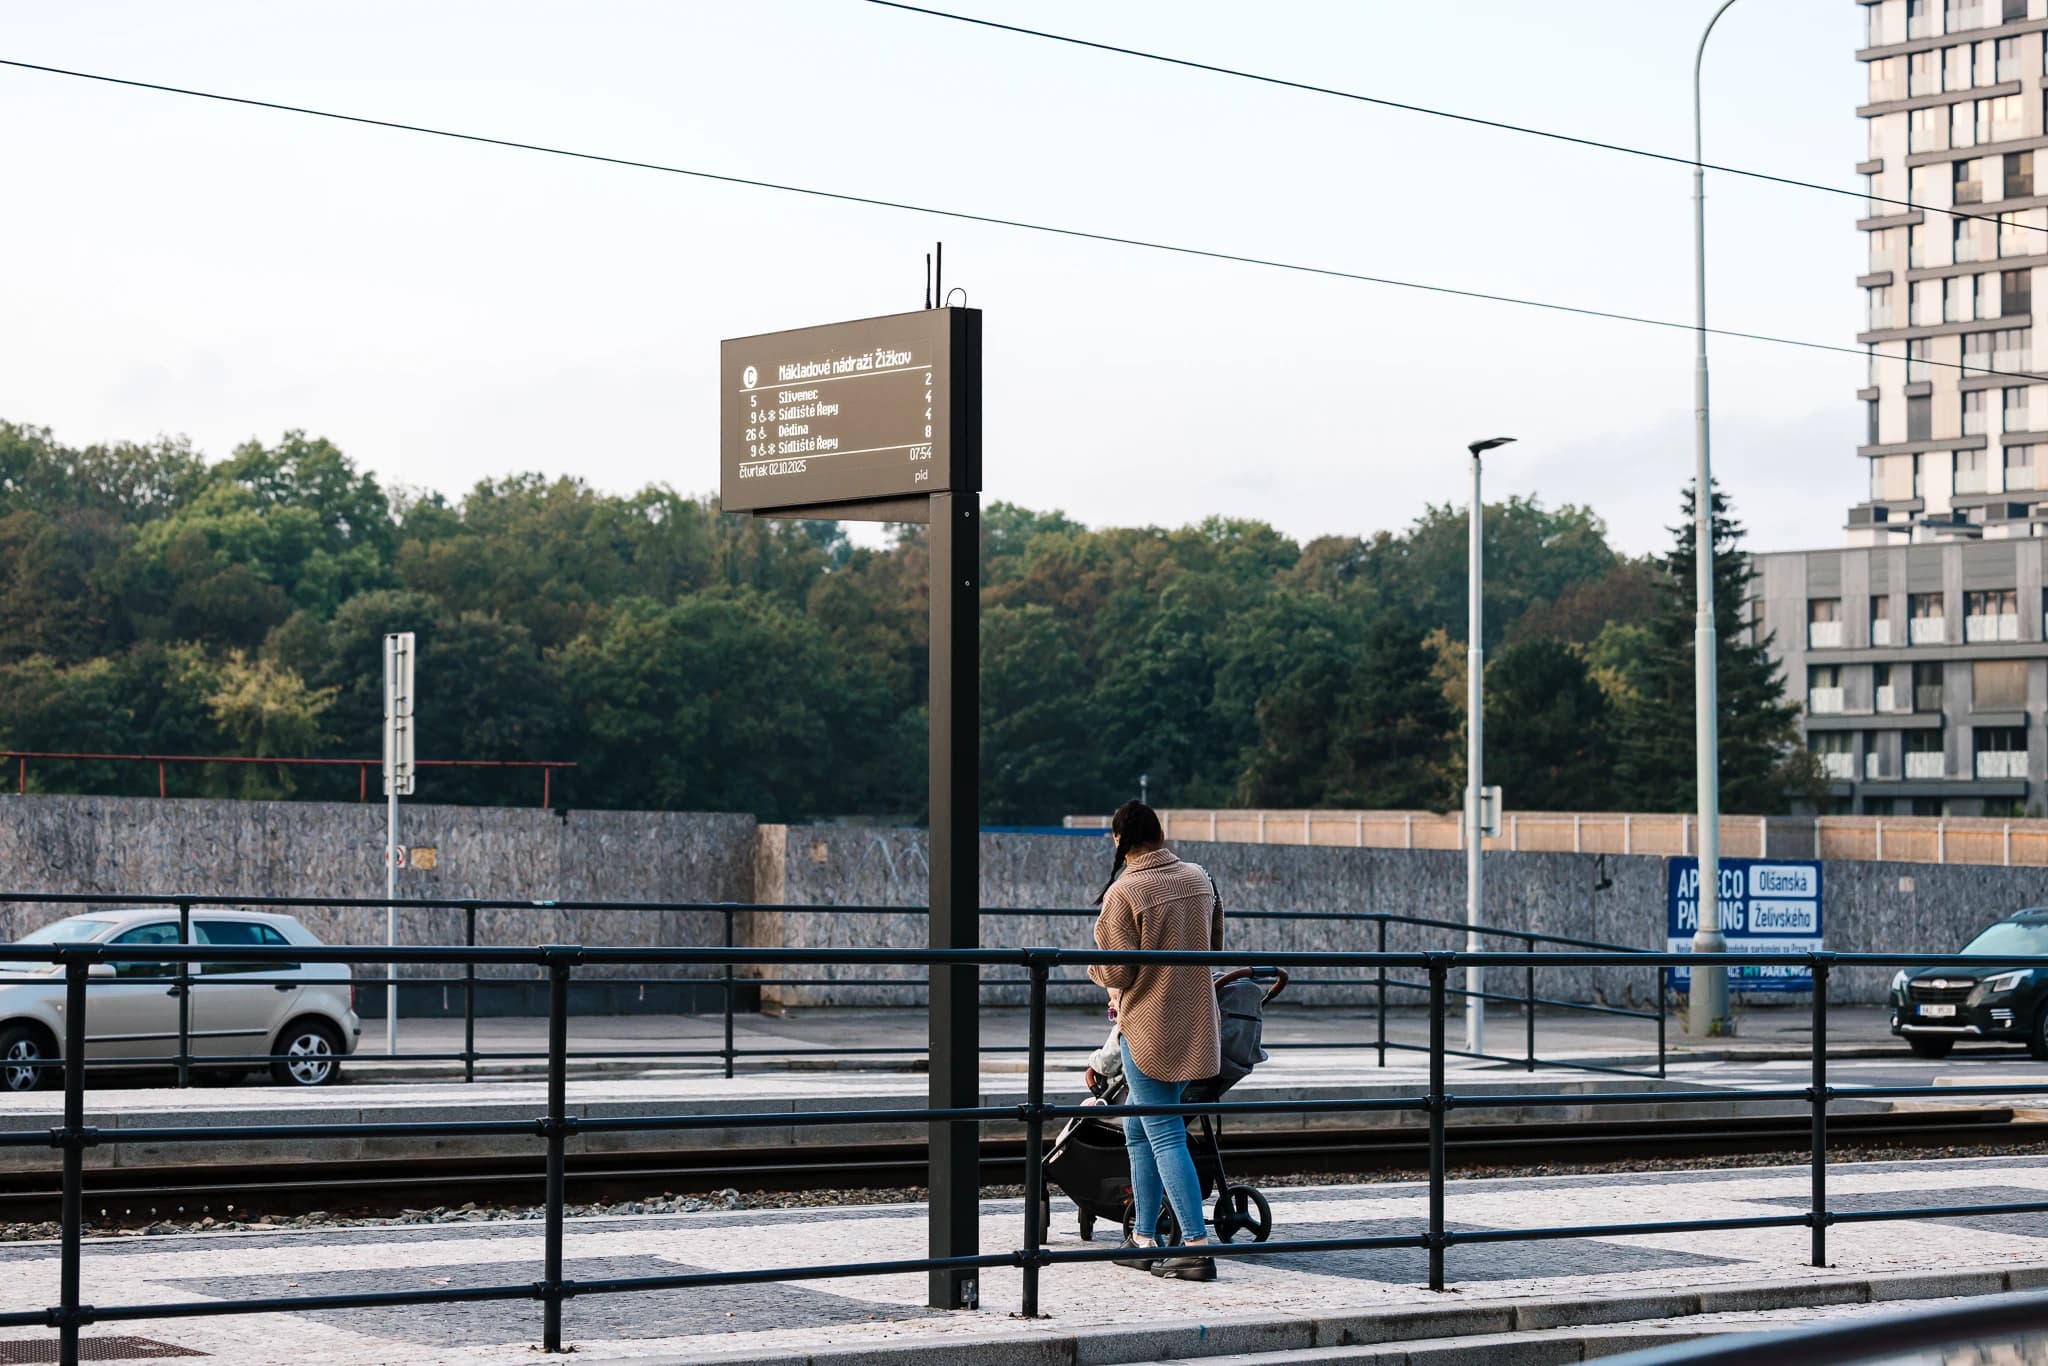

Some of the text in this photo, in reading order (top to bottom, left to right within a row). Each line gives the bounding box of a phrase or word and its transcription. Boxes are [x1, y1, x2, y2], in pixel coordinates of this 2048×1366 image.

[778, 361, 830, 382] Nákladové
[832, 353, 873, 374] nádraží
[875, 348, 912, 369] Žižkov
[750, 372, 932, 408] 5 Slivenec 2
[745, 407, 932, 442] 26 Dědina 4
[750, 390, 932, 425] 9 Sídliště Řepy 4
[750, 424, 932, 458] 9 Sídliště Řepy 8
[739, 446, 932, 480] čtvrtek 02.10.2025 07:54
[915, 469, 928, 484] pid
[1677, 868, 1744, 899] APCO
[1759, 870, 1807, 893] Olšanská
[1677, 900, 1744, 931] PAING
[1754, 903, 1812, 928] Želivského
